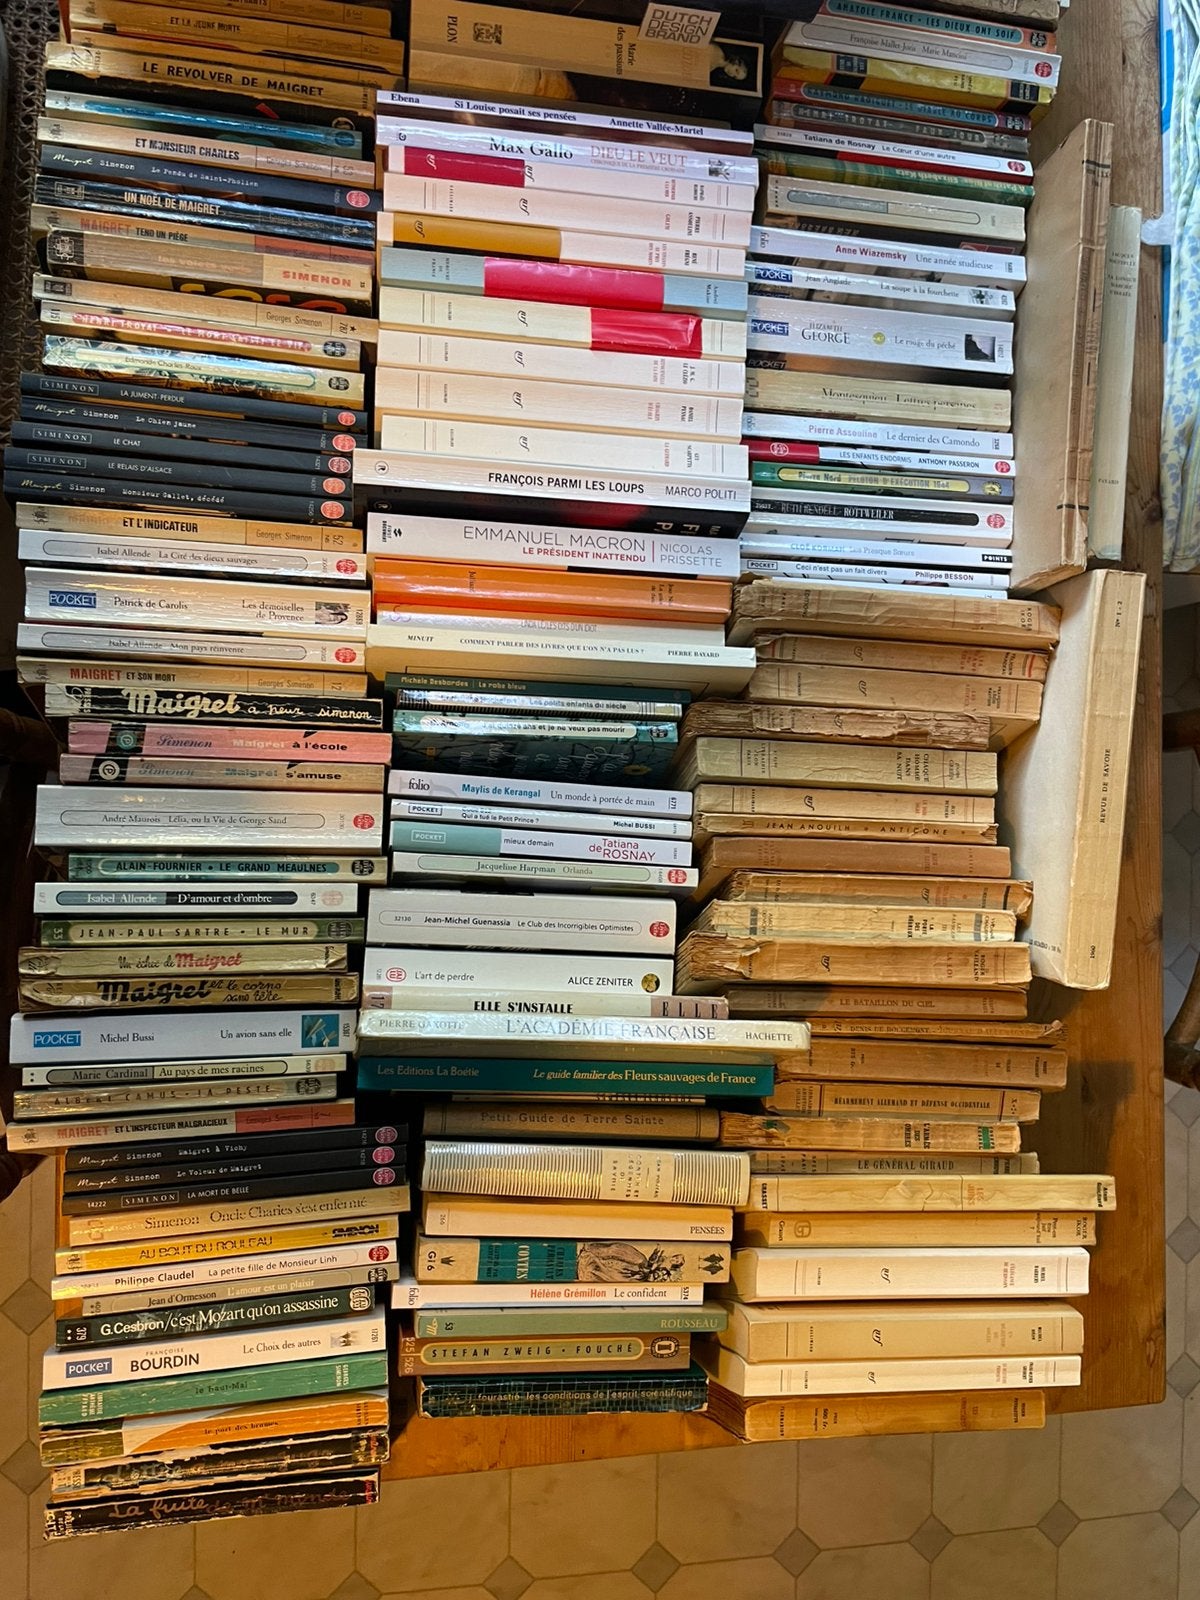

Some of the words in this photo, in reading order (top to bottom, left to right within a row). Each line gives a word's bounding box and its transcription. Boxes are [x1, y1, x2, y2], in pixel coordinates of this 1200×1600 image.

[652, 8, 713, 27] DUTCH
[447, 15, 458, 44] PLON
[650, 19, 707, 36] DESIGN
[880, 10, 914, 23] FRANCE
[925, 17, 940, 28] LES
[944, 20, 972, 33] DIEUX
[975, 25, 991, 36] ONT
[995, 28, 1015, 40] SOIF
[646, 29, 700, 45] BRAND
[143, 62, 158, 75] LE
[167, 65, 232, 85] REVOLVER
[241, 75, 258, 88] DE
[267, 78, 324, 97] MAIGRET
[391, 93, 420, 104] Ebena
[454, 100, 464, 111] Si
[466, 102, 496, 114] Louise
[499, 105, 526, 117] posait
[527, 107, 543, 118] ses
[543, 109, 576, 121] pensées
[610, 118, 643, 129] Annette
[646, 121, 704, 135] Vallée-Martel
[489, 137, 524, 154] Max
[529, 142, 573, 159] Gallo
[804, 134, 833, 146] Tatiana
[835, 138, 845, 147] de
[848, 139, 876, 151] Rosnay
[881, 144, 891, 152] Le
[915, 148, 936, 158] d'une
[937, 151, 956, 160] autre
[835, 245, 857, 257] Anne
[860, 247, 907, 262] Wiazemsky
[916, 253, 932, 264] Une
[934, 255, 956, 267] année
[958, 258, 993, 270] studieuse
[282, 269, 352, 287] SIMENON
[886, 431, 897, 441] Le
[897, 432, 924, 443] dernier
[925, 434, 940, 444] des
[941, 436, 980, 447] Camondo
[918, 457, 947, 467] ANTHONY
[949, 459, 979, 468] PASSERON
[488, 472, 543, 487] FRANÇOIS
[547, 476, 582, 489] PARMI
[586, 479, 605, 491] LES
[609, 480, 644, 493] LOUPS
[665, 486, 701, 499] MARCO
[704, 487, 736, 500] POLITI
[123, 517, 134, 528] ET
[137, 518, 198, 533] L'INDICATEUR
[464, 526, 564, 546] EMMANUEL
[570, 533, 645, 551] MACRON
[522, 547, 535, 556] LE
[537, 548, 590, 559] PRÉSIDENT
[592, 551, 646, 562] INATTENDU
[660, 543, 712, 555] NICOLAS
[660, 555, 722, 567] PRISSETTE
[983, 554, 1008, 562] POINTS
[796, 564, 811, 572] Ceci
[812, 564, 829, 573] n'est
[830, 565, 843, 573] pas
[845, 566, 854, 574] un
[868, 567, 887, 575] divers
[915, 571, 943, 582] Philippe
[944, 573, 974, 581] BESSON
[1102, 748, 1112, 777] SAVOIE
[408, 778, 430, 792] folio
[462, 784, 489, 795] Maylis
[489, 786, 502, 796] de
[504, 787, 541, 798] Kerangal
[1102, 777, 1108, 793] DE
[550, 790, 562, 801] Un
[564, 792, 591, 802] monde
[593, 794, 598, 803] à
[600, 794, 623, 804] portée
[624, 796, 635, 805] de
[636, 797, 655, 806] main
[589, 843, 602, 854] de
[602, 839, 639, 850] Tatiana
[602, 849, 656, 862] ROSNAY
[116, 862, 202, 872] ALAIN-FOURNIER
[219, 862, 233, 872] LE
[238, 862, 270, 872] GRAND
[87, 893, 116, 903] Isabel
[117, 893, 157, 903] Allende
[178, 893, 220, 903] D'amour
[223, 893, 232, 903] et
[234, 893, 272, 903] d'ombre
[424, 915, 469, 925] Jean-Michel
[472, 917, 511, 927] Guenassia
[557, 922, 596, 930] Incorrigibles
[599, 923, 634, 932] Optimistes
[415, 971, 433, 981] L'art
[436, 971, 445, 982] de
[446, 971, 474, 984] perdre
[567, 976, 593, 986] ALICE
[595, 976, 634, 987] ZENITER
[34, 1033, 80, 1046] POCKET
[100, 1034, 131, 1043] Michel
[134, 1034, 155, 1043] Bussi
[220, 1029, 233, 1040] Un
[235, 1029, 256, 1039] avion
[258, 1028, 277, 1038] sans
[278, 1028, 292, 1038] elle
[745, 1031, 793, 1041] HACHETTE
[73, 1069, 100, 1081] Marie
[105, 1068, 148, 1080] Cardinal
[159, 1066, 173, 1077] Au
[175, 1065, 195, 1076] pays
[197, 1065, 208, 1075] de
[209, 1064, 228, 1075] mes
[230, 1063, 264, 1074] racines
[857, 1160, 870, 1170] LE
[918, 1160, 954, 1170] GIRAUD
[690, 1225, 725, 1236] PENSÉES
[208, 1267, 217, 1277] La
[220, 1263, 246, 1276] petite
[248, 1262, 264, 1272] fille
[266, 1260, 276, 1271] de
[279, 1256, 318, 1269] Monsieur
[320, 1254, 338, 1266] Linh
[115, 1275, 155, 1289] Philippe
[158, 1270, 195, 1284] Claudel
[530, 1288, 562, 1298] Hélène
[564, 1288, 606, 1298] Grémillon
[614, 1289, 625, 1298] Le
[627, 1289, 667, 1298] confident
[199, 1306, 245, 1325] Mozart
[247, 1302, 281, 1319] qu'on
[283, 1295, 338, 1314] assassine
[243, 1344, 254, 1354] Le
[256, 1341, 279, 1353] Choix
[282, 1340, 296, 1350] des
[297, 1337, 321, 1349] autres
[432, 1347, 490, 1358] STEFAN
[503, 1345, 551, 1356] ZWEIG
[576, 1343, 633, 1354] FOUCHÉ
[130, 1353, 200, 1373] BOURDIN
